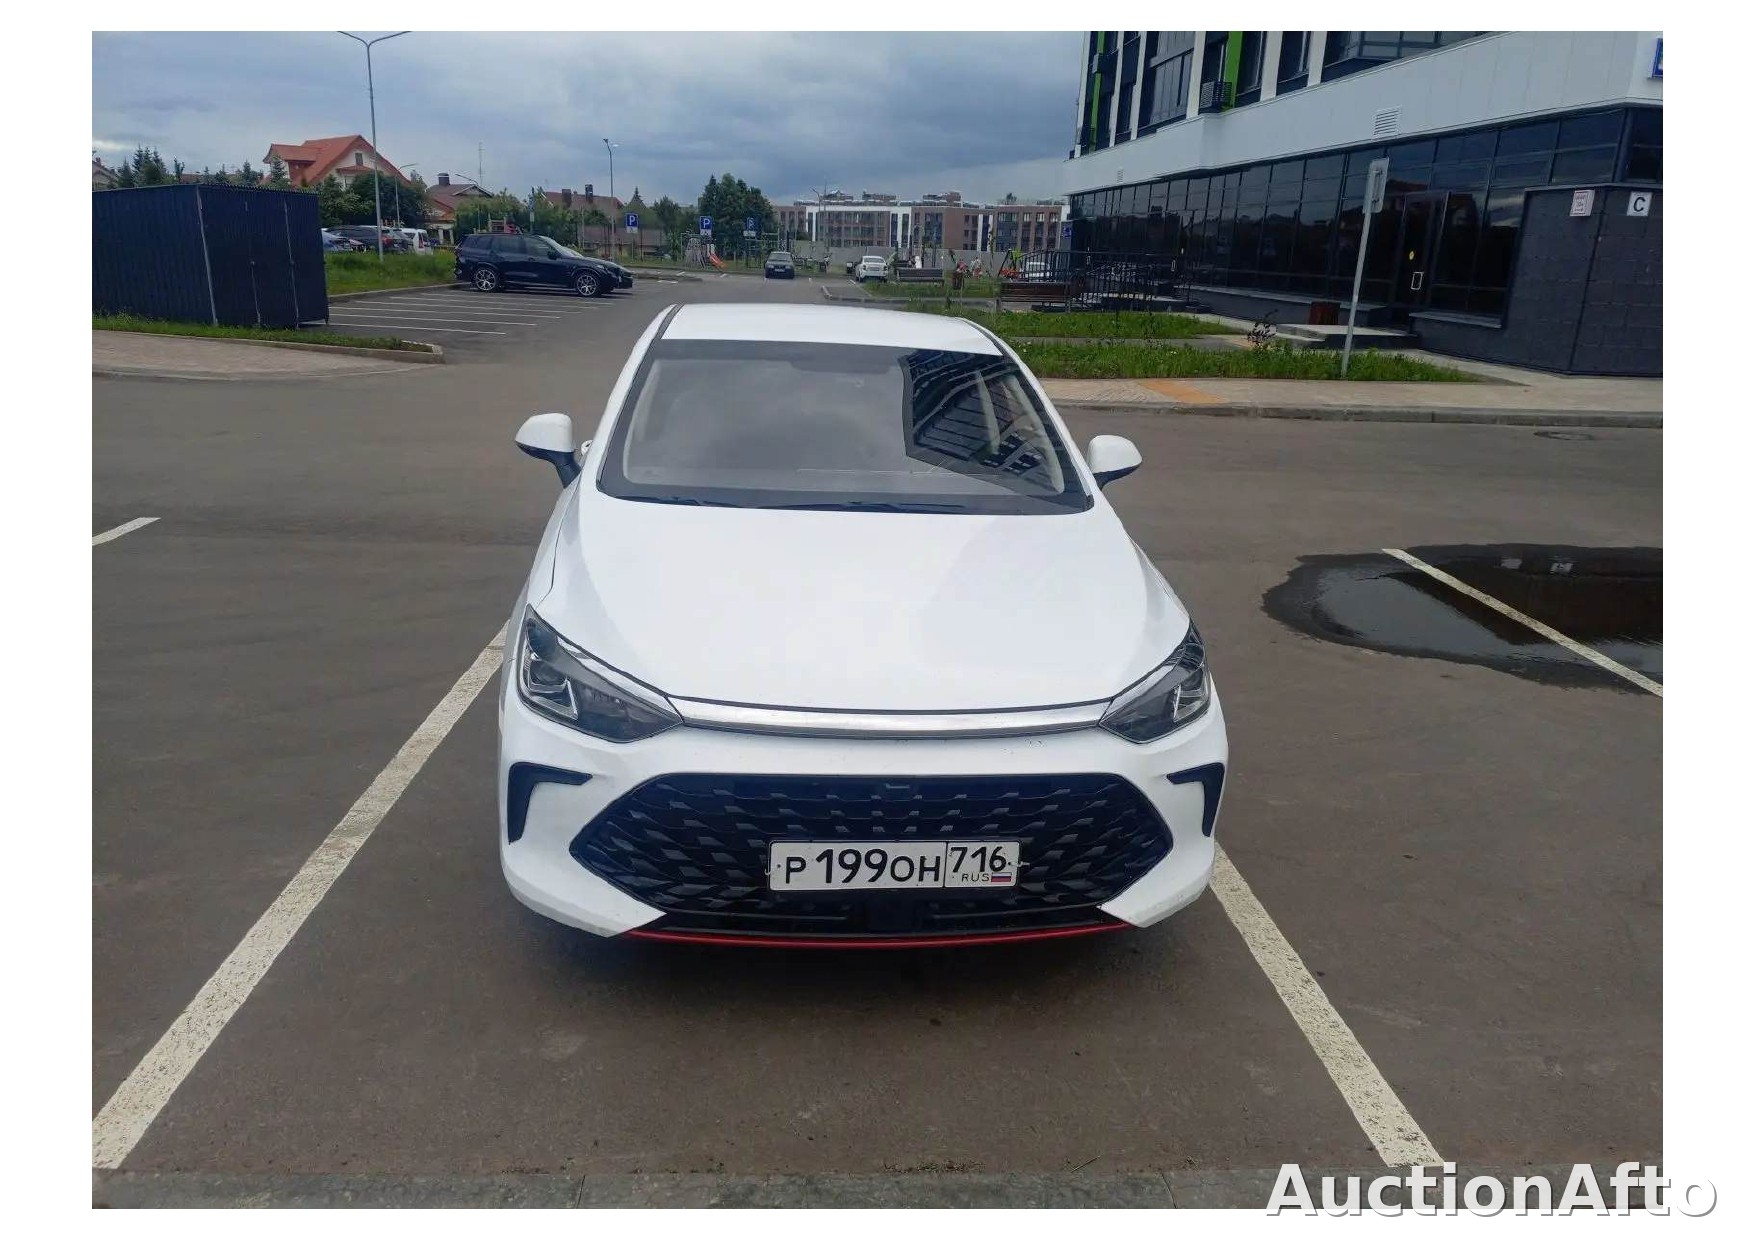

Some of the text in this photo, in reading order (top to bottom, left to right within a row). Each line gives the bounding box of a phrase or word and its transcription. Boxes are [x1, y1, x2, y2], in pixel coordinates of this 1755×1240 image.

[629, 215, 636, 226] P
[703, 218, 711, 229] P
[950, 846, 1007, 873] 716
[961, 873, 990, 882] RUS
